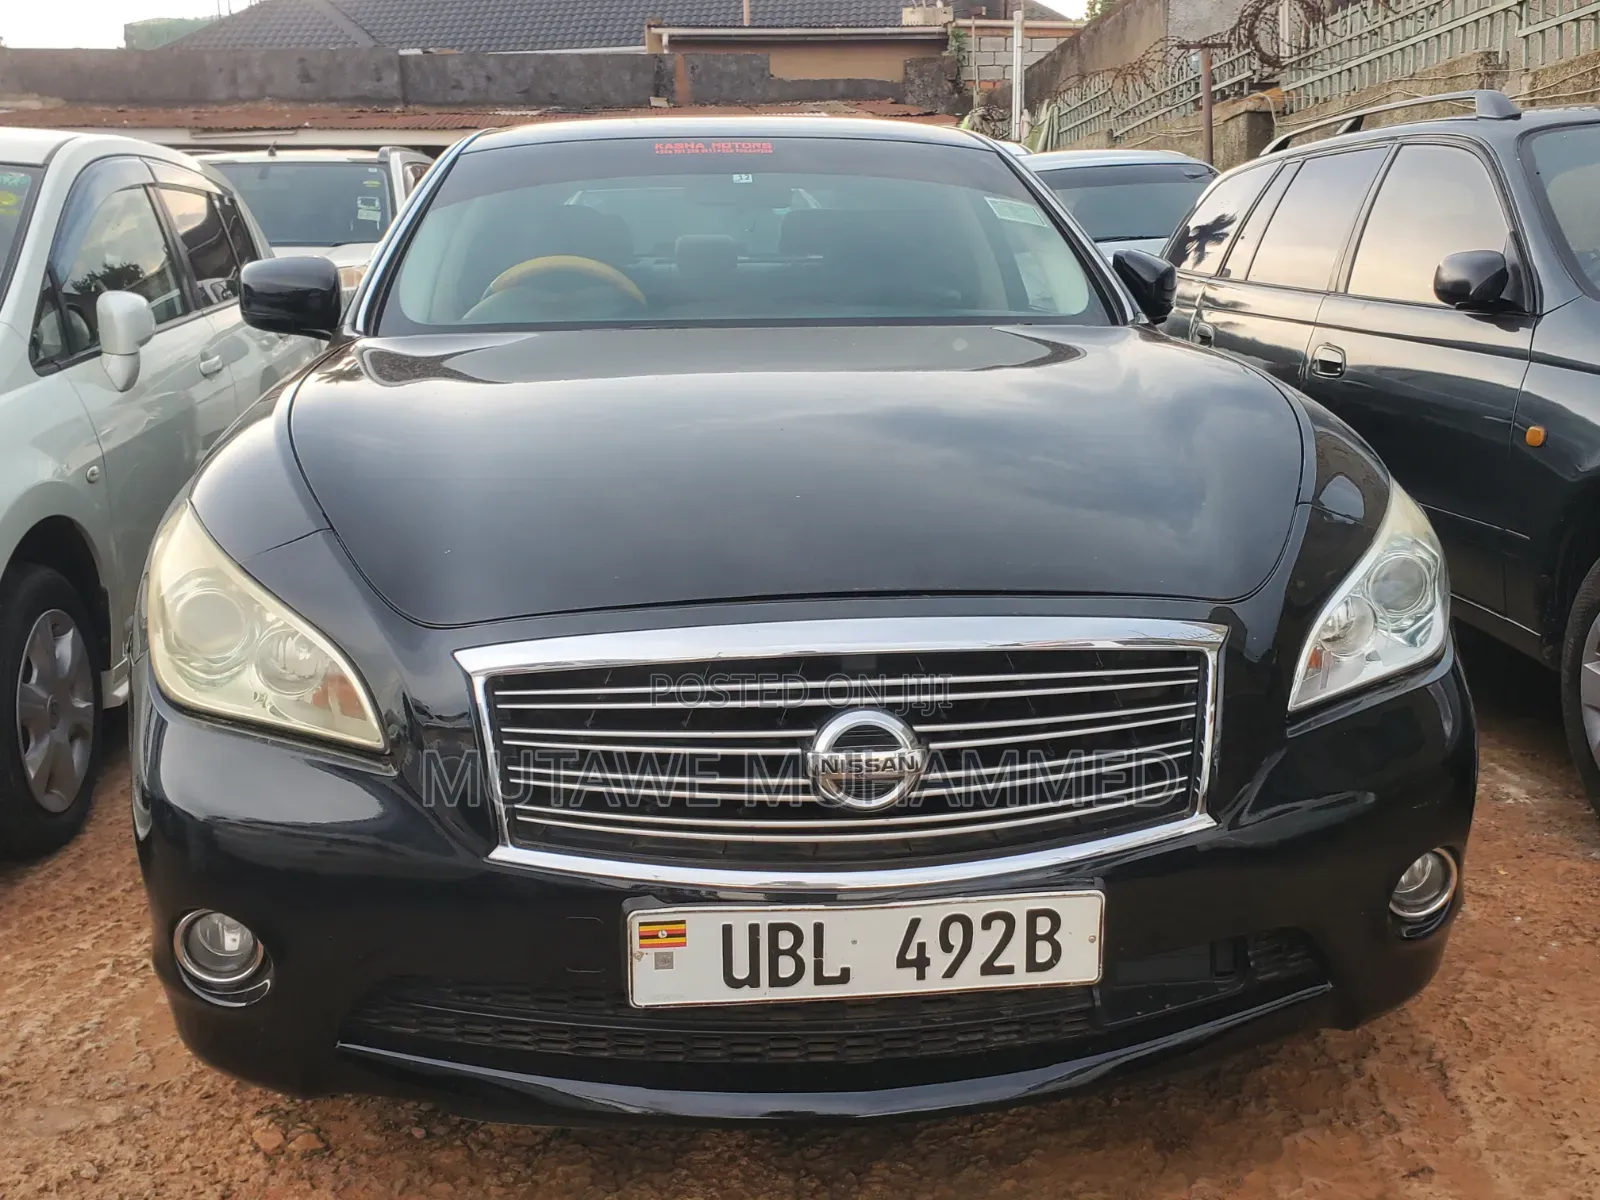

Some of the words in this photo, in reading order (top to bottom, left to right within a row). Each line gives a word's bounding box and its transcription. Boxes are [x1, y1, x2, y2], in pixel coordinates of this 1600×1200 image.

[820, 754, 917, 776] NISSAN
[721, 921, 851, 989] UBL
[896, 907, 1063, 981] 492B
